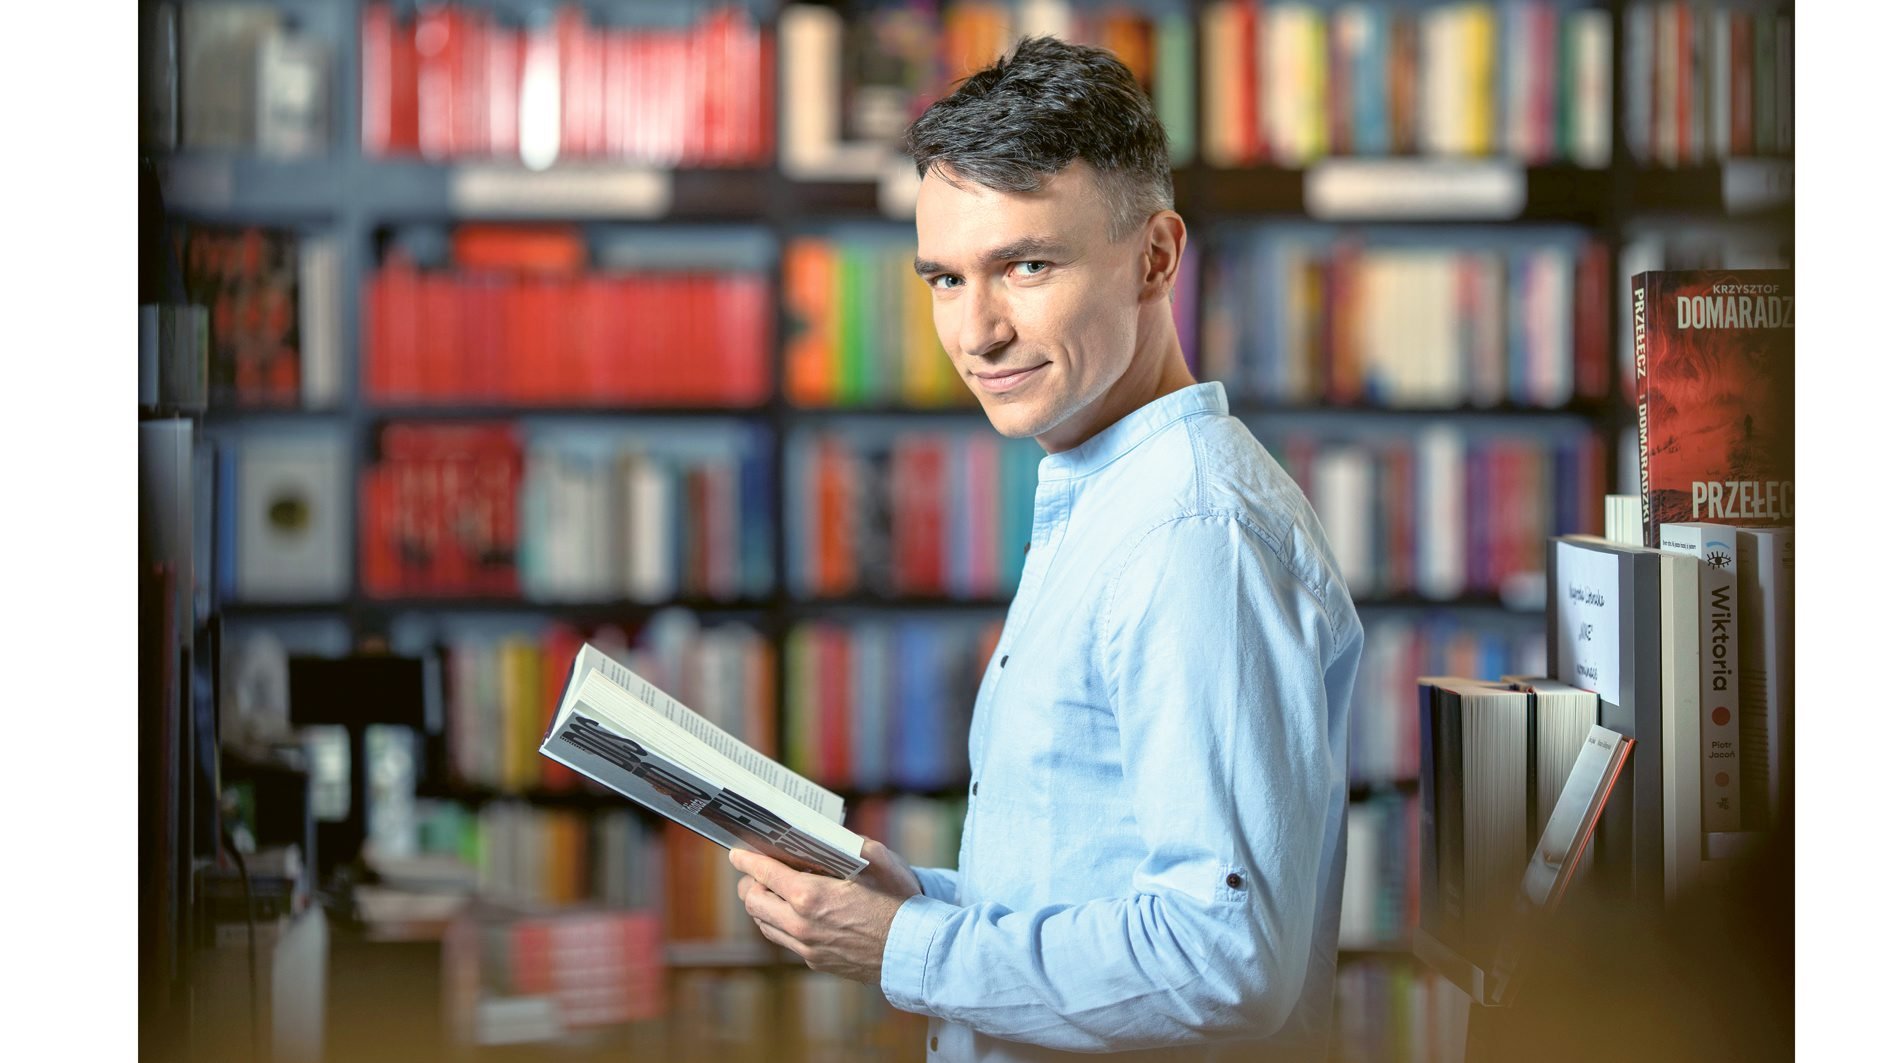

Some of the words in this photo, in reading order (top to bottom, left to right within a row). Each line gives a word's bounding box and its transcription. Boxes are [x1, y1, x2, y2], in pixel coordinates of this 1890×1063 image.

[1713, 284, 1779, 294] KRZYSZTOF
[1634, 287, 1647, 379] PRZEŁĘCZ
[1638, 402, 1650, 523] DOMARADZKI
[1711, 585, 1732, 691] Wiktoria
[561, 716, 648, 773] DOS
[1711, 740, 1733, 750] Piotr
